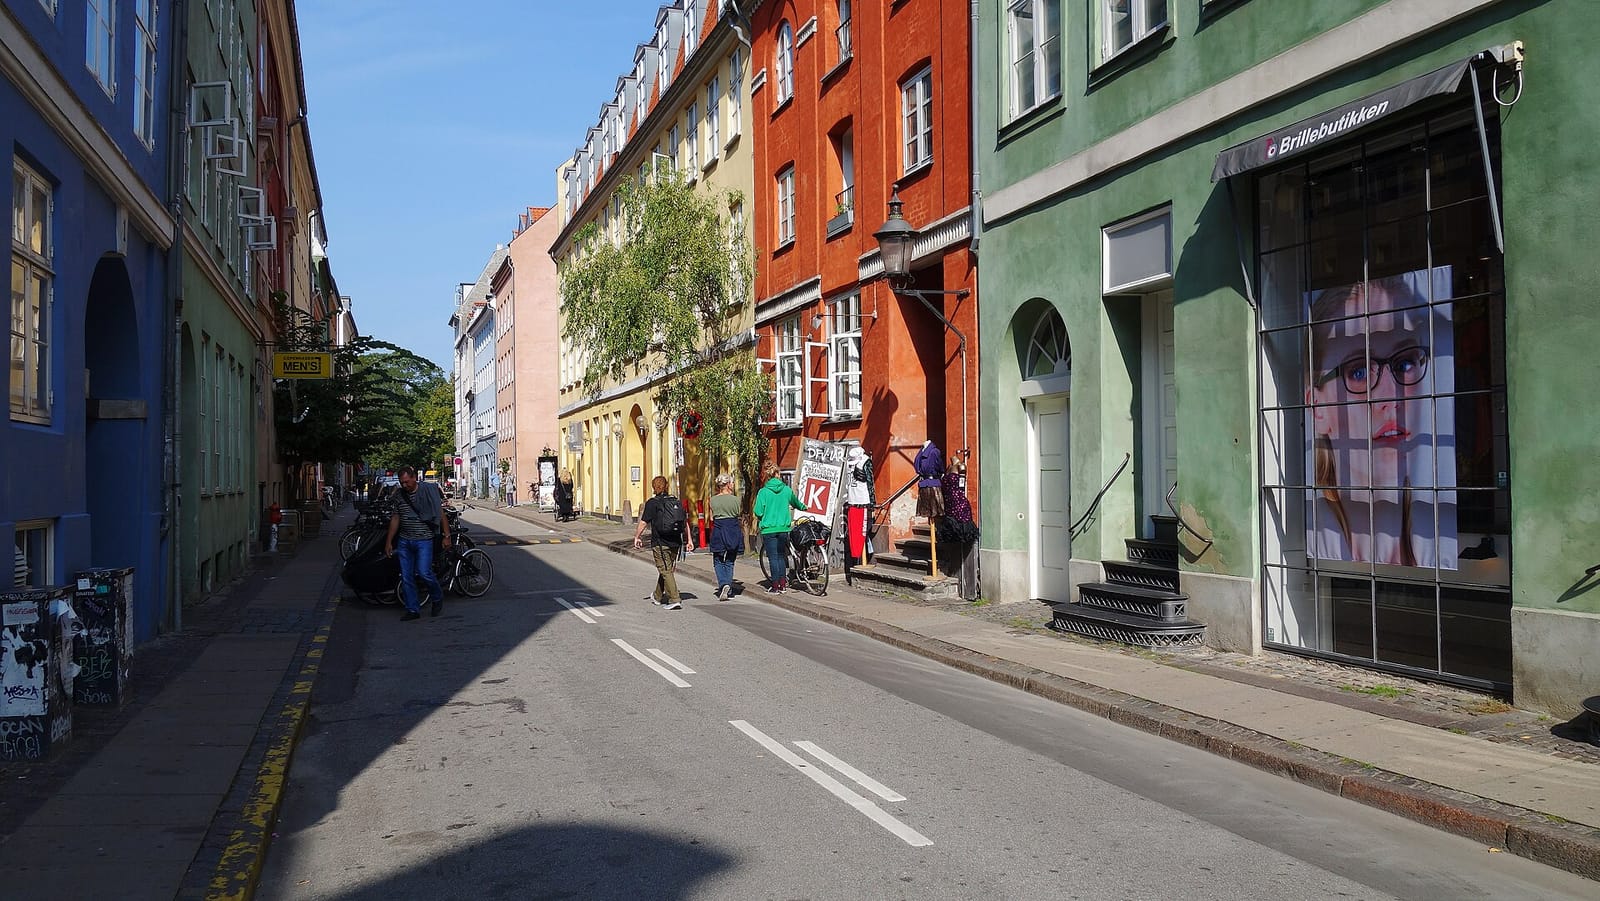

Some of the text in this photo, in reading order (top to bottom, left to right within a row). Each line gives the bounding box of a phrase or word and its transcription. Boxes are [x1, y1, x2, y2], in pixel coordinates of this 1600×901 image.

[1279, 100, 1389, 155] Brillebutikken
[283, 361, 318, 371] MEN'S
[807, 483, 826, 511] K
